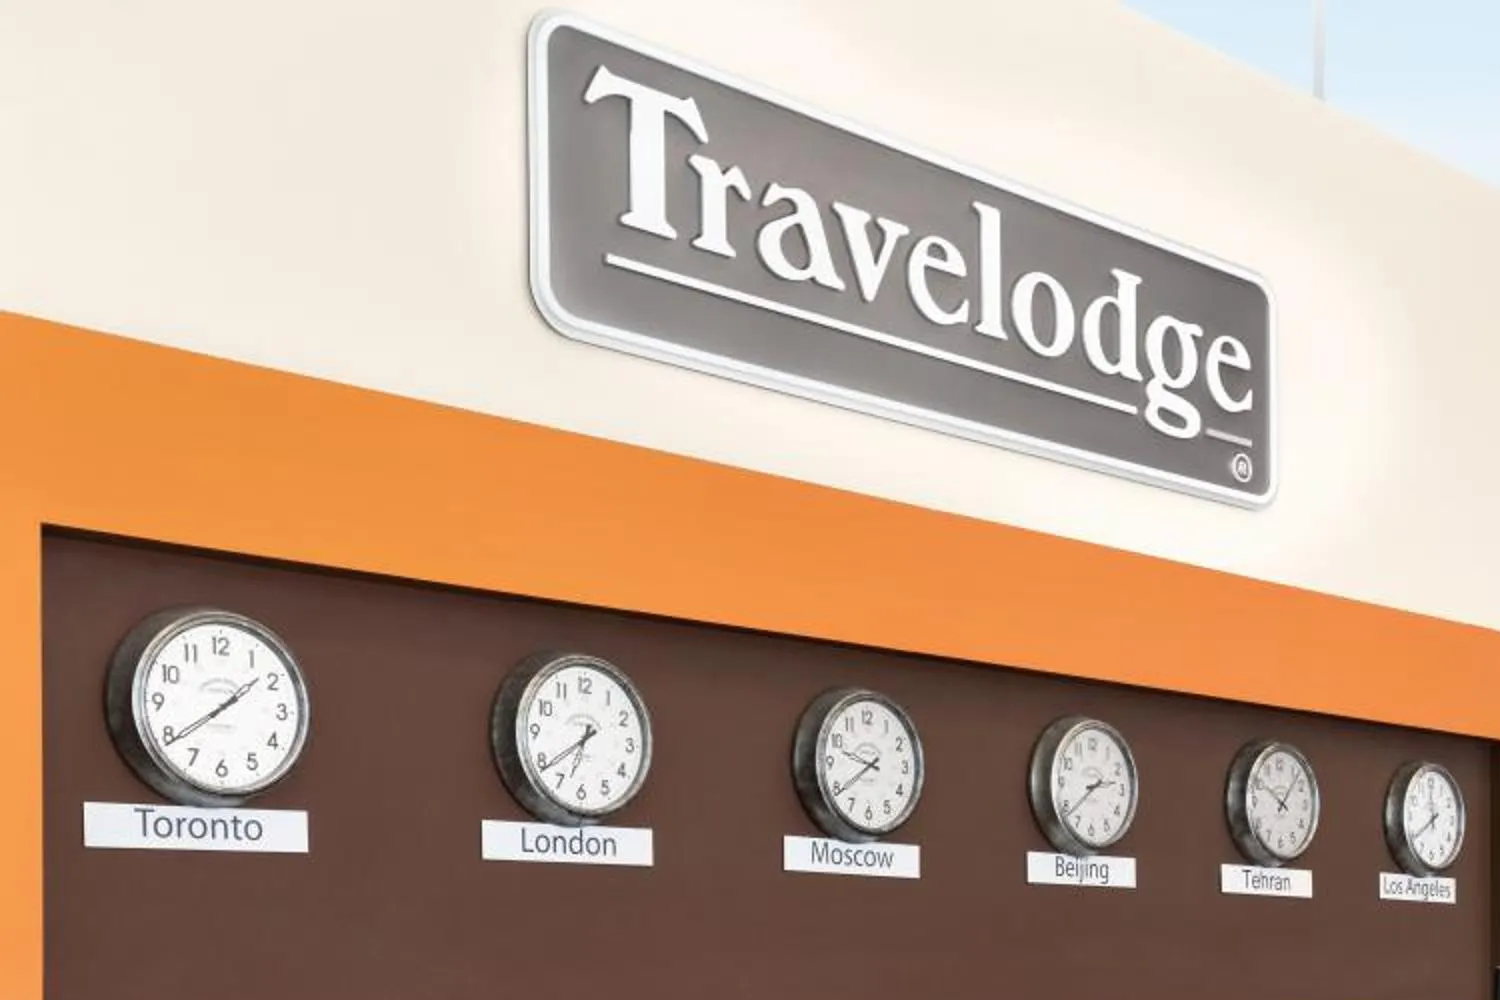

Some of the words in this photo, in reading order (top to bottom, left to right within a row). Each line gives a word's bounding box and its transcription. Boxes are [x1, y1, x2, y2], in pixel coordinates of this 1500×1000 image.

[584, 64, 1254, 439] Travelodge
[184, 643, 197, 663] 11
[211, 636, 230, 656] 12
[249, 651, 254, 668] 1
[162, 664, 180, 684] 10
[267, 673, 279, 691] 2
[555, 682, 567, 700] 11
[578, 676, 592, 694] 12
[152, 692, 165, 712] 9
[606, 690, 611, 706] 1
[276, 703, 288, 721] 3
[539, 700, 553, 717] 10
[861, 710, 873, 725] 12
[619, 711, 629, 727] 2
[845, 717, 855, 732] 11
[163, 725, 175, 744] 8
[529, 723, 540, 739] 9
[267, 732, 278, 750] 4
[625, 737, 634, 753] 3
[832, 733, 843, 748] 10
[896, 737, 903, 752] 2
[188, 748, 200, 766] 7
[247, 753, 258, 771] 5
[537, 752, 547, 770] 8
[826, 756, 834, 770] 9
[216, 759, 228, 778] 6
[617, 762, 626, 778] 4
[902, 761, 908, 774] 3
[556, 773, 565, 789] 7
[600, 780, 609, 795] 5
[896, 784, 903, 795] 4
[576, 784, 586, 800] 6
[848, 798, 856, 812] 7
[865, 806, 873, 820] 6
[884, 800, 891, 814] 5
[134, 807, 263, 841] Toronto
[521, 827, 617, 857] London
[811, 840, 894, 869] Moscow
[1055, 856, 1109, 884] Beijing
[1242, 869, 1292, 891] Tehran
[1384, 876, 1403, 894] Los
[1406, 879, 1451, 900] Angeles
